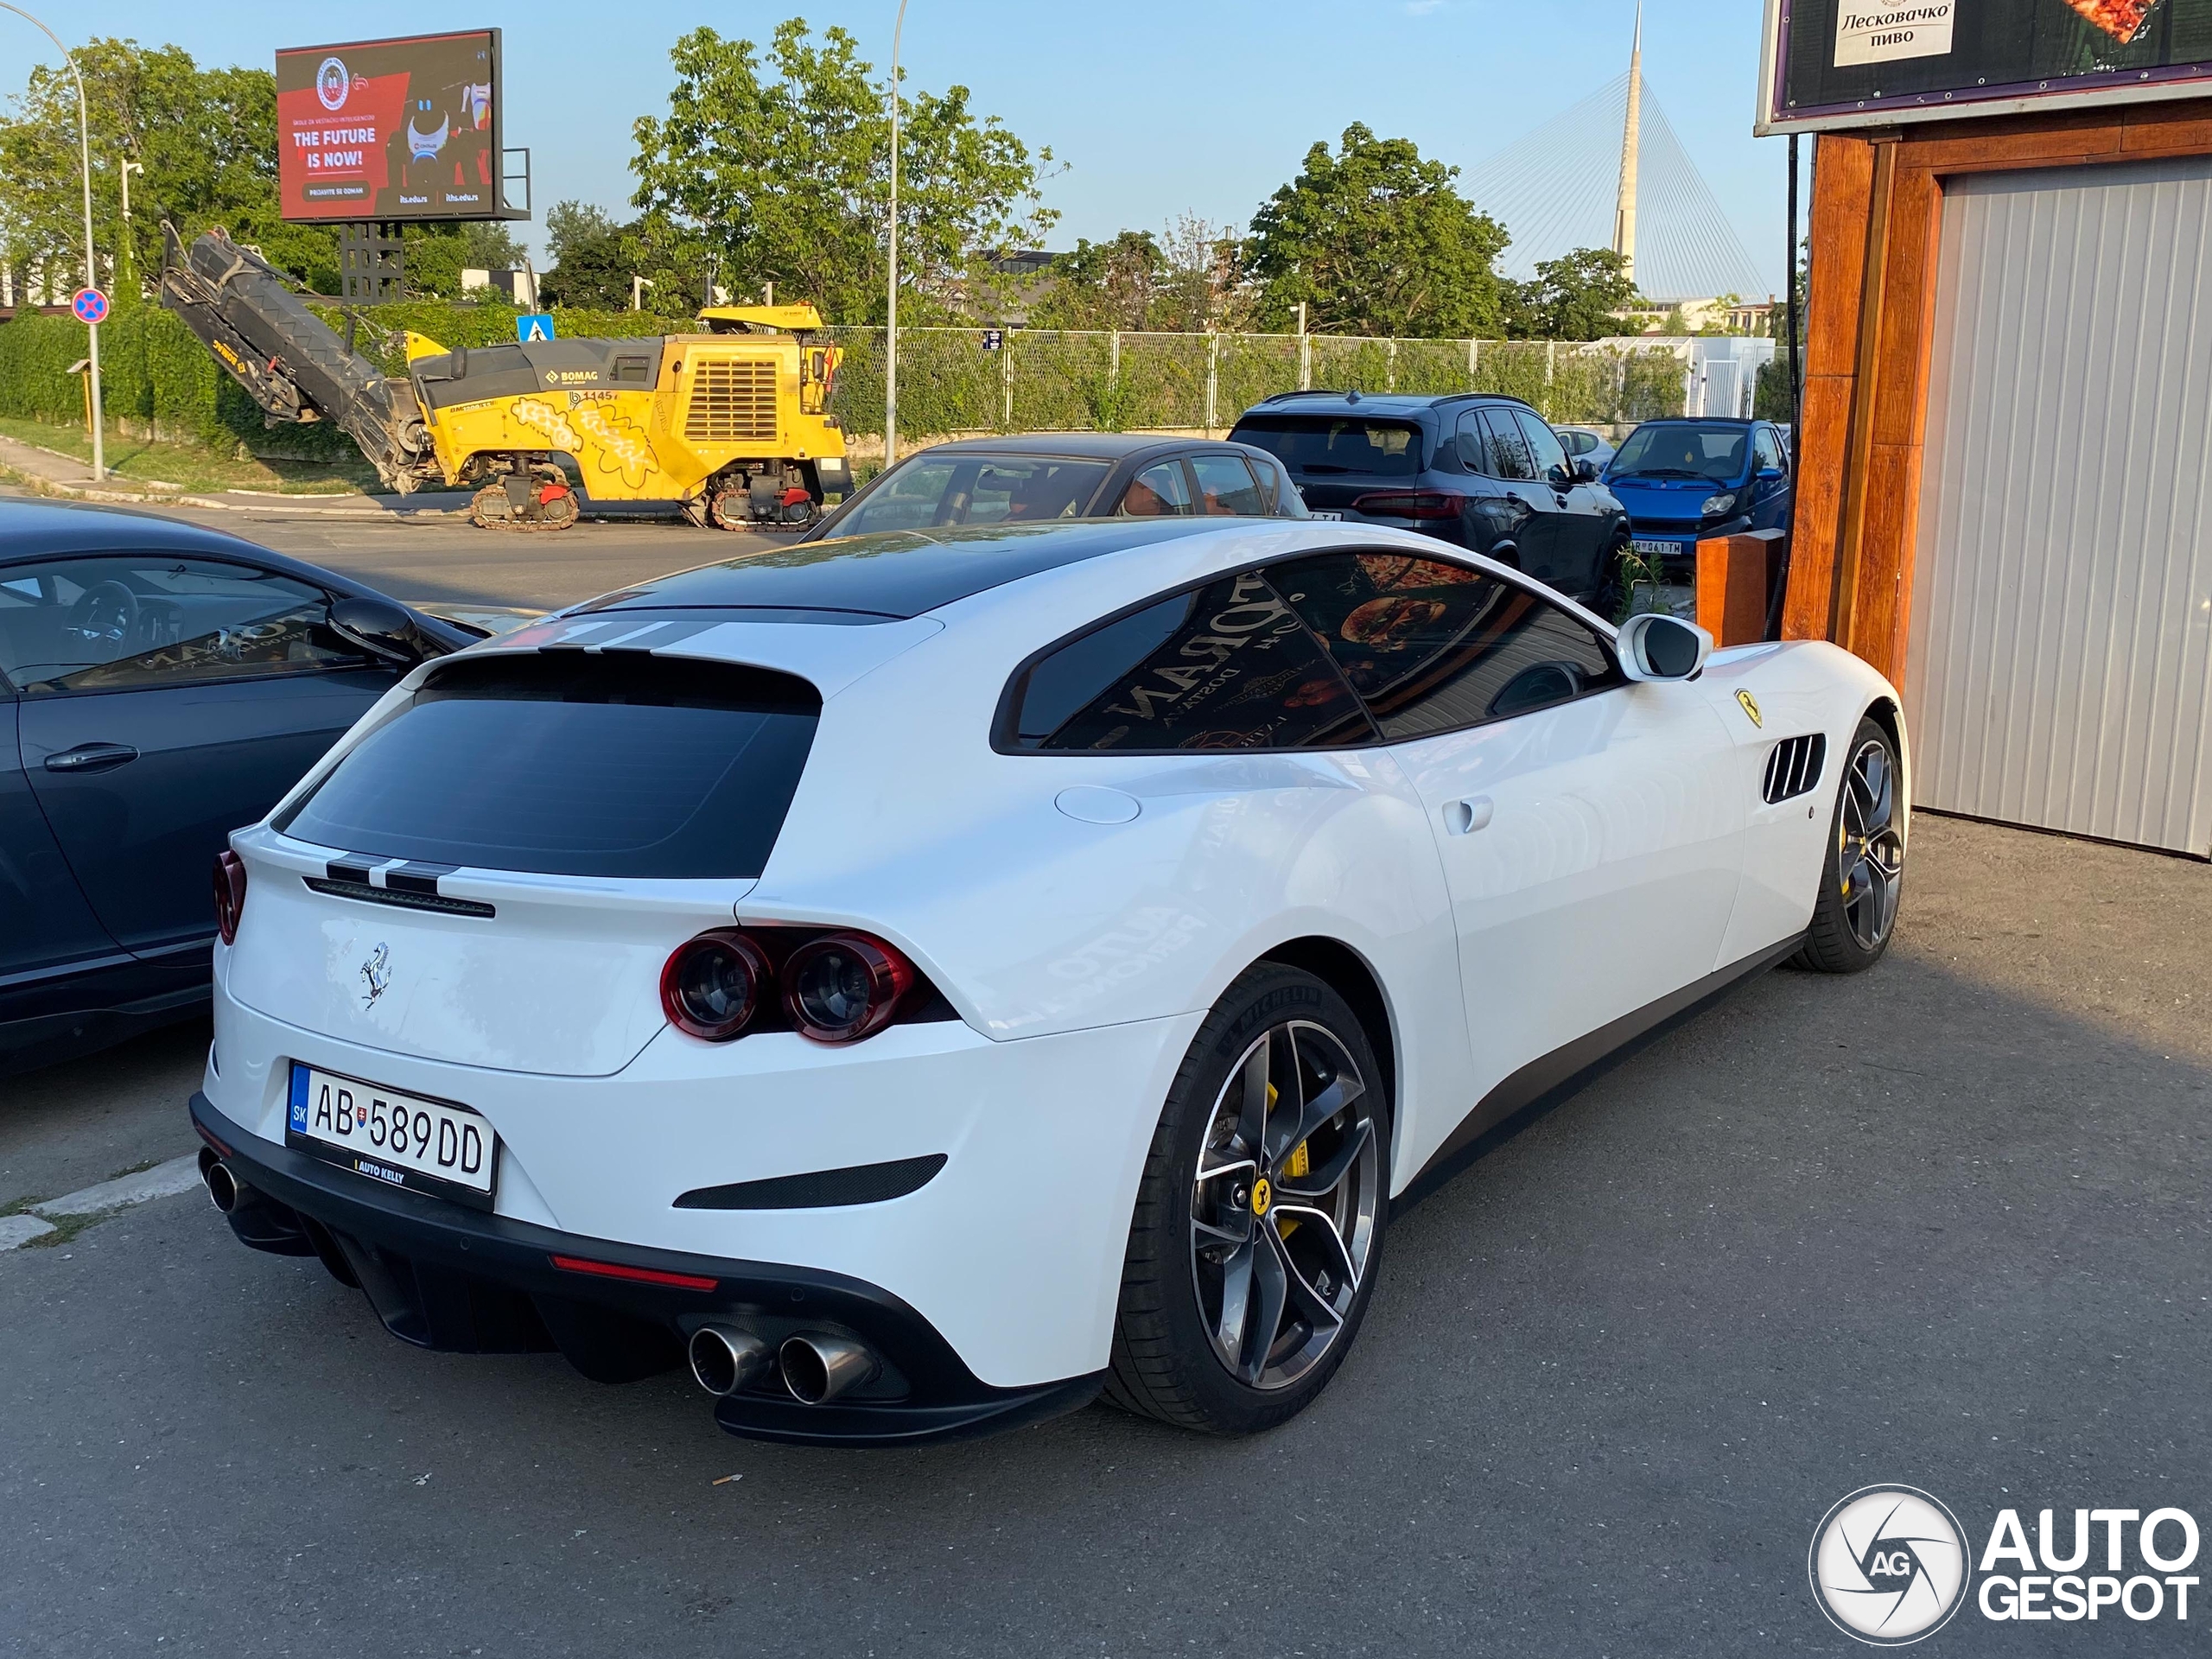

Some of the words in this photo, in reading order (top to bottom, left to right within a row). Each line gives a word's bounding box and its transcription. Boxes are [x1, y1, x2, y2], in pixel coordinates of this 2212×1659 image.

[1841, 5, 1948, 30] Лесковачко
[1870, 30, 1914, 47] пиво
[293, 131, 320, 147] THE
[322, 127, 376, 145] FUTURE
[308, 153, 321, 168] IS
[324, 150, 363, 167] NOW!
[561, 372, 598, 381] BOMAG
[293, 1105, 307, 1123] SK
[315, 1084, 354, 1135] AB
[359, 1160, 380, 1176] AUTO
[381, 1167, 404, 1184] KELLY
